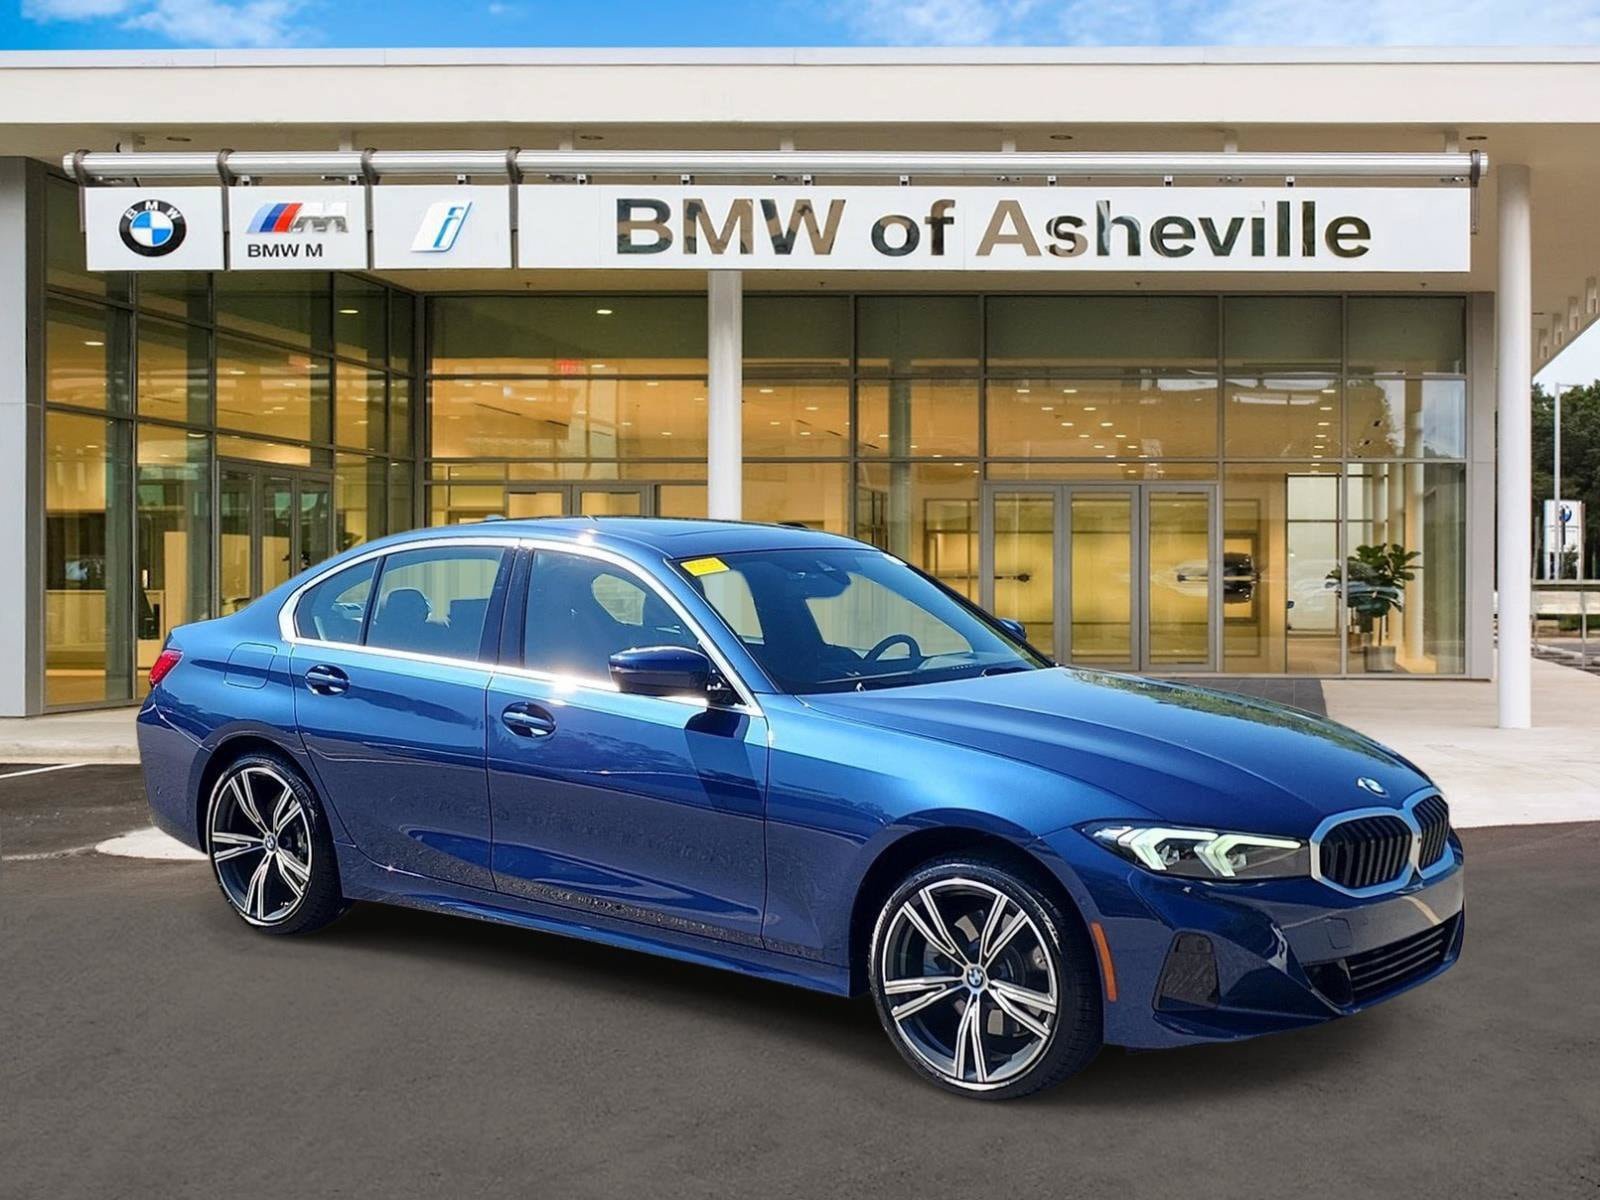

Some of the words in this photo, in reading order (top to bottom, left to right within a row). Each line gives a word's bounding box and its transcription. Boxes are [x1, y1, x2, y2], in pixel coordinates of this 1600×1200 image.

[125, 200, 182, 220] BMW
[616, 198, 846, 256] BMW
[870, 198, 956, 257] of
[975, 199, 1372, 258] Asheville
[247, 243, 300, 258] BMW
[305, 243, 323, 258] M
